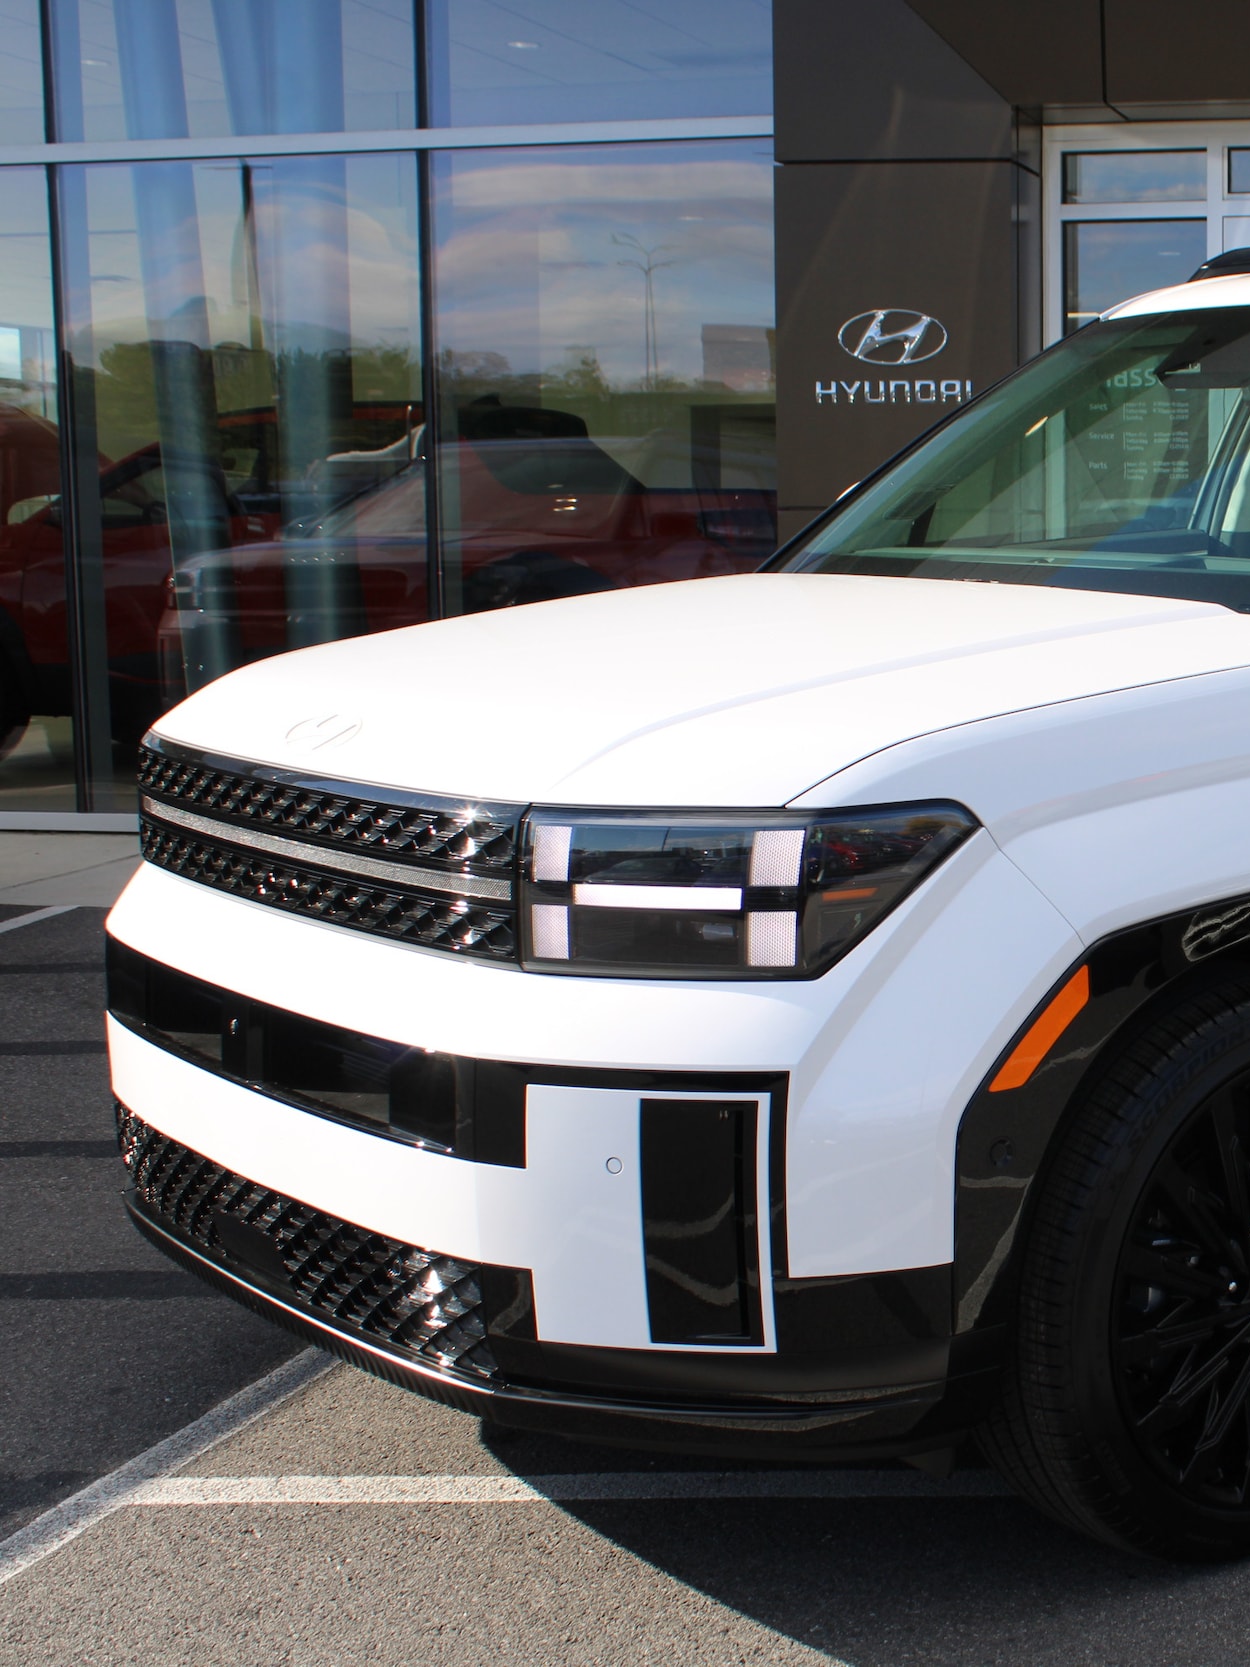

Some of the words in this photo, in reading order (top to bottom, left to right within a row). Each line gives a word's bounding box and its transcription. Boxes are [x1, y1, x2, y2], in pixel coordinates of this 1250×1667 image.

[815, 379, 973, 404] HYUNDAI
[1089, 432, 1115, 440] Service
[1089, 461, 1108, 470] Parts
